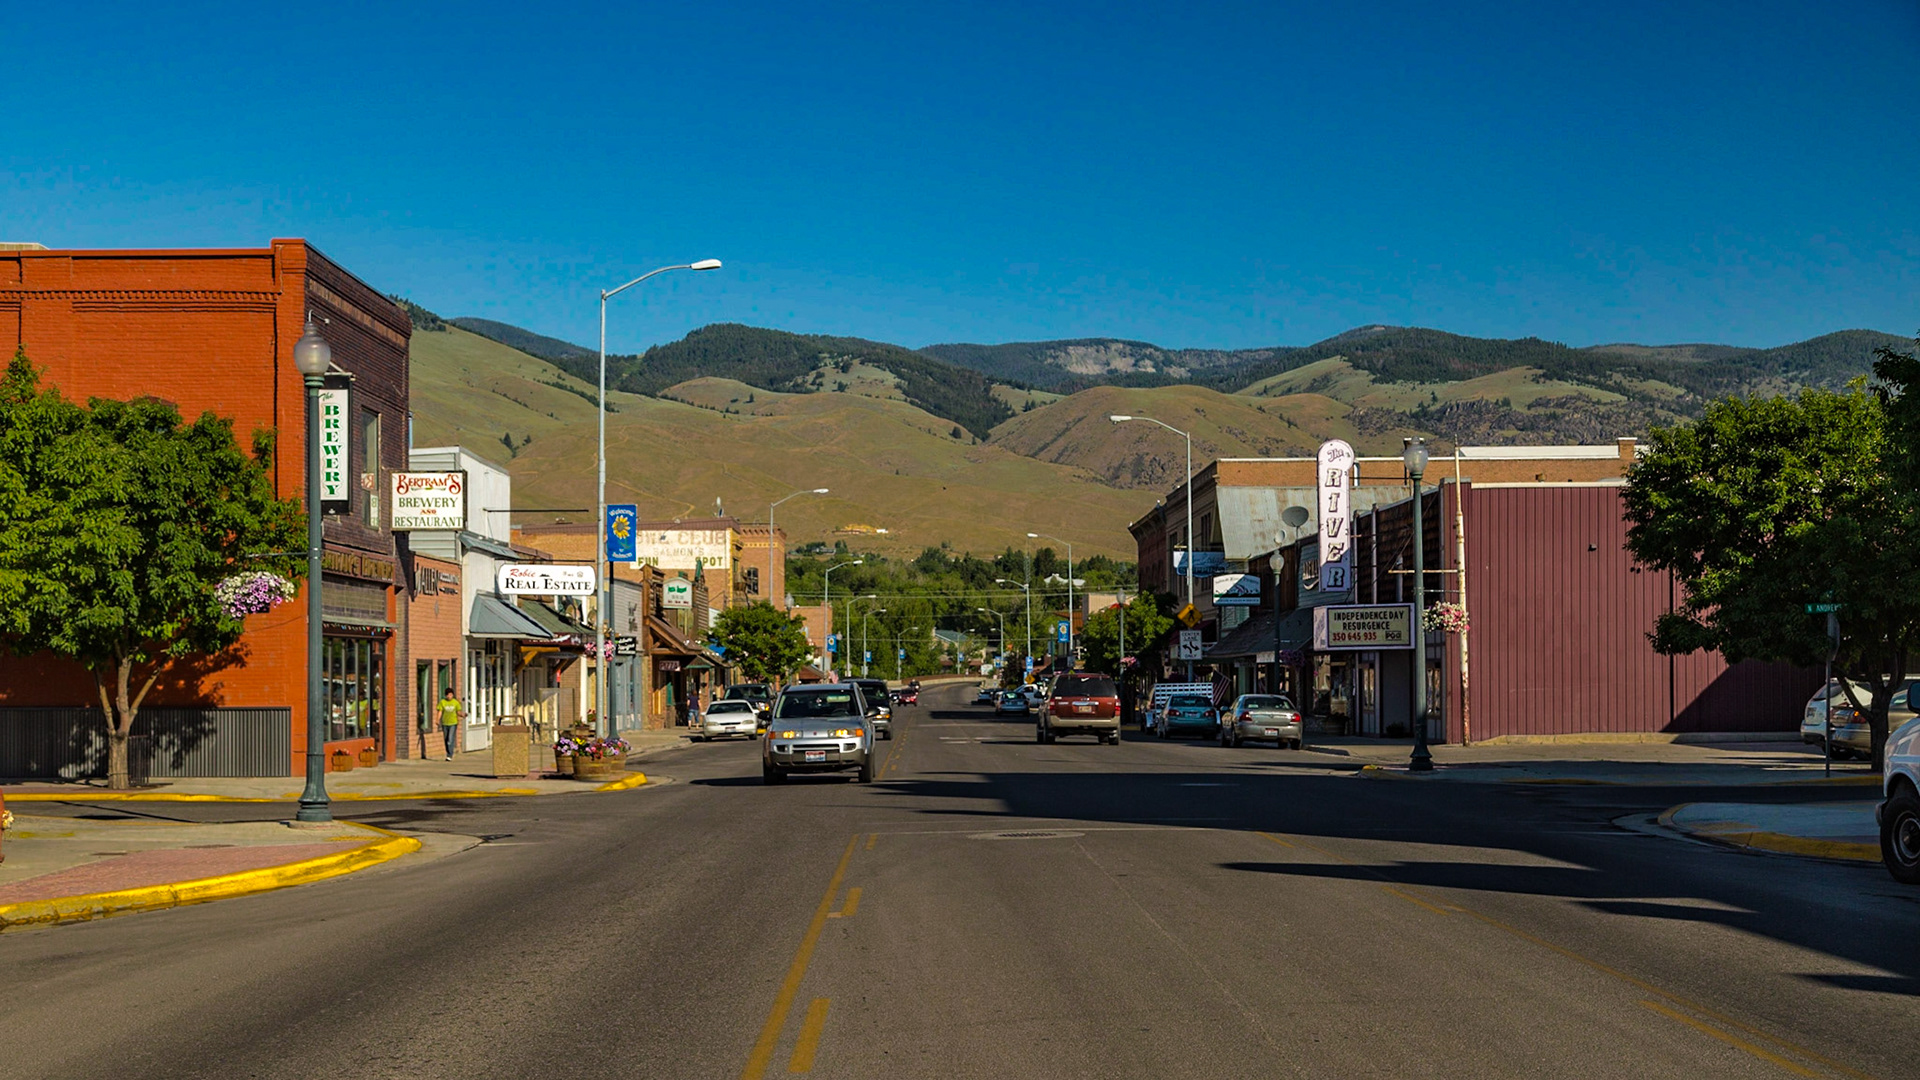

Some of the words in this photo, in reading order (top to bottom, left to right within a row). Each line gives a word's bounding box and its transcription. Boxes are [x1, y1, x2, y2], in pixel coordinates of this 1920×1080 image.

[323, 405, 342, 495] BREWERY
[396, 474, 461, 495] BERTRAM'S
[398, 497, 458, 508] BREWERY
[394, 516, 462, 527] RESTAURANT
[1325, 468, 1344, 588] RIVER
[677, 530, 726, 546] CLUB
[653, 546, 704, 557] SALMON'S
[638, 557, 659, 566] FUN
[505, 577, 540, 589] REAL
[544, 578, 592, 591] ESTATE
[1333, 611, 1387, 621] INDEPENDENCE
[1388, 610, 1404, 620] DAY
[1342, 621, 1390, 631] RESURGENCE
[1332, 632, 1346, 641] 350
[1347, 632, 1361, 641] 645
[1363, 631, 1377, 641] 935
